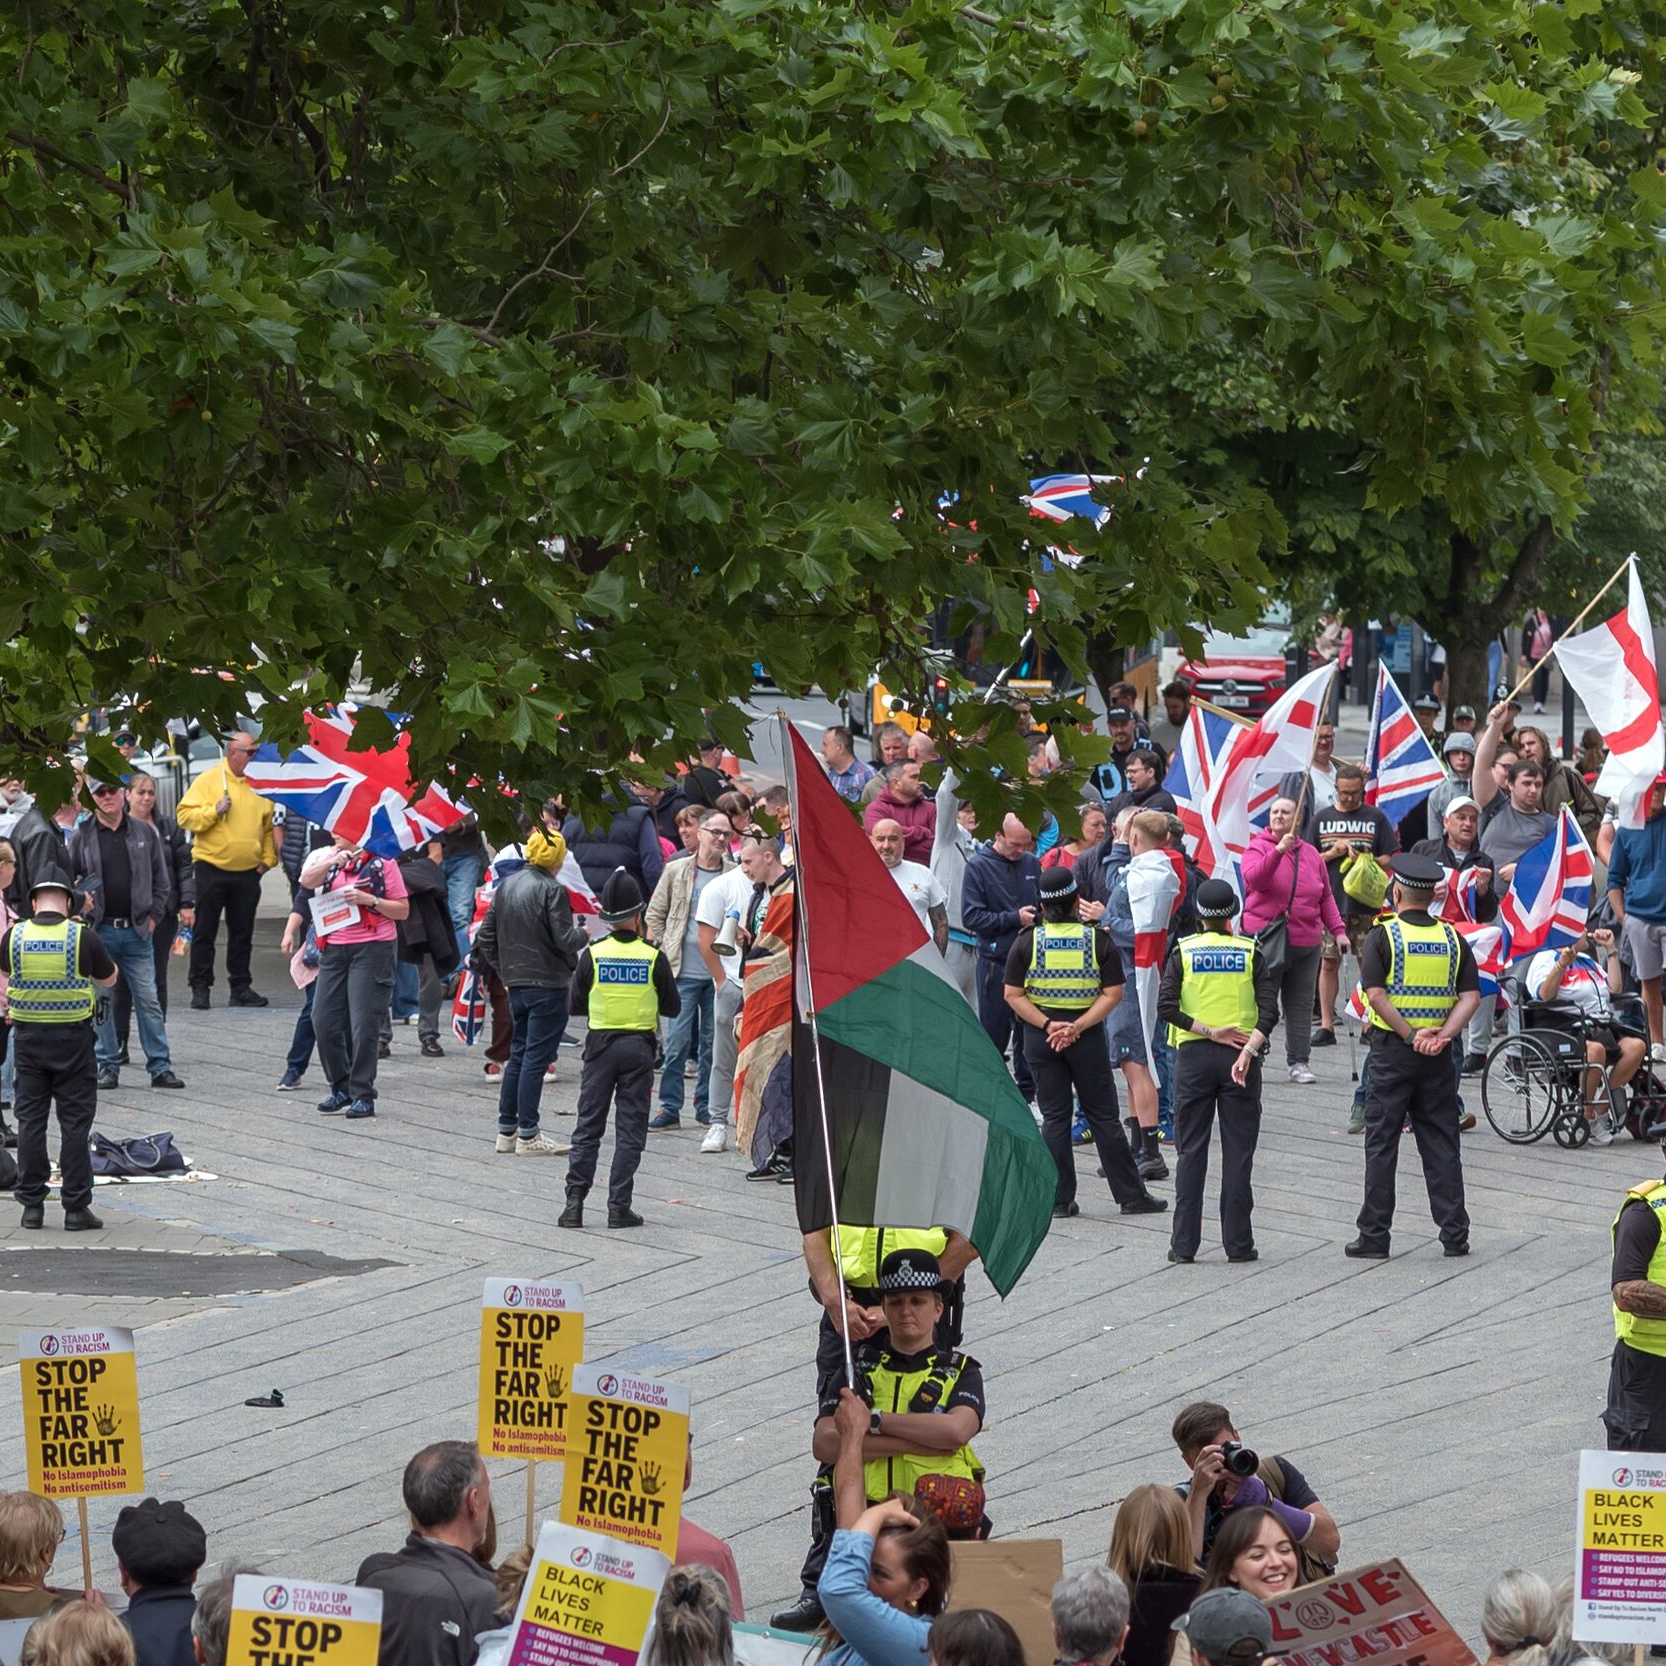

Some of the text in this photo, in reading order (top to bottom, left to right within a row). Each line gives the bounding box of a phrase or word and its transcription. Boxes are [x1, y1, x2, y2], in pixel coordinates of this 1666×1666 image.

[1319, 821, 1375, 834] LUDWIG
[24, 941, 62, 951] POLICE
[1045, 938, 1084, 949] POLICE
[1410, 943, 1448, 954] POLICE
[1194, 954, 1243, 970] POLICE
[600, 967, 647, 981] POLICE
[524, 1287, 562, 1298] STAND UP
[525, 1297, 566, 1309] TO RACISM
[496, 1311, 561, 1341] STOP
[61, 1333, 105, 1344] STAND UP
[62, 1342, 110, 1354] TO RACISM
[495, 1341, 543, 1369] THE
[35, 1359, 106, 1386] STOP
[495, 1370, 541, 1399] FAR
[622, 1378, 665, 1395] STAND UP
[37, 1386, 89, 1413] THE
[621, 1388, 669, 1407] TO RACISM
[494, 1398, 568, 1429] RIGHT
[586, 1399, 661, 1436] STOP
[39, 1415, 89, 1440] FAR
[493, 1428, 567, 1443] No Islamophobia
[42, 1438, 124, 1468] RIGHT
[492, 1442, 565, 1456] No antisemitism
[585, 1428, 639, 1463] THE
[43, 1466, 127, 1481] No Islamophobia
[581, 1457, 634, 1491] FAR
[1635, 1469, 1663, 1478] STAND
[44, 1480, 126, 1494] No antisemitism
[1636, 1479, 1647, 1487] TO
[578, 1486, 665, 1527] RIGHT
[1594, 1493, 1654, 1508] BLACK
[576, 1515, 662, 1541] No Islamophobia
[1593, 1513, 1643, 1527] LIVES
[1592, 1532, 1664, 1547] MATTER
[595, 1553, 634, 1569] STAND UP
[593, 1562, 635, 1580] TO RACISM
[546, 1566, 606, 1595] BLACK
[293, 1588, 347, 1602] STAND UP
[540, 1586, 590, 1612] LIVES
[293, 1600, 352, 1616] TO RACISM
[533, 1605, 604, 1636] MATTER
[251, 1616, 342, 1653] STOP
[536, 1627, 606, 1655] REFUGEES WELCOME
[532, 1640, 546, 1653] SAY
[547, 1645, 558, 1656] NO
[558, 1648, 568, 1658] TO
[529, 1651, 555, 1666] STAMP
